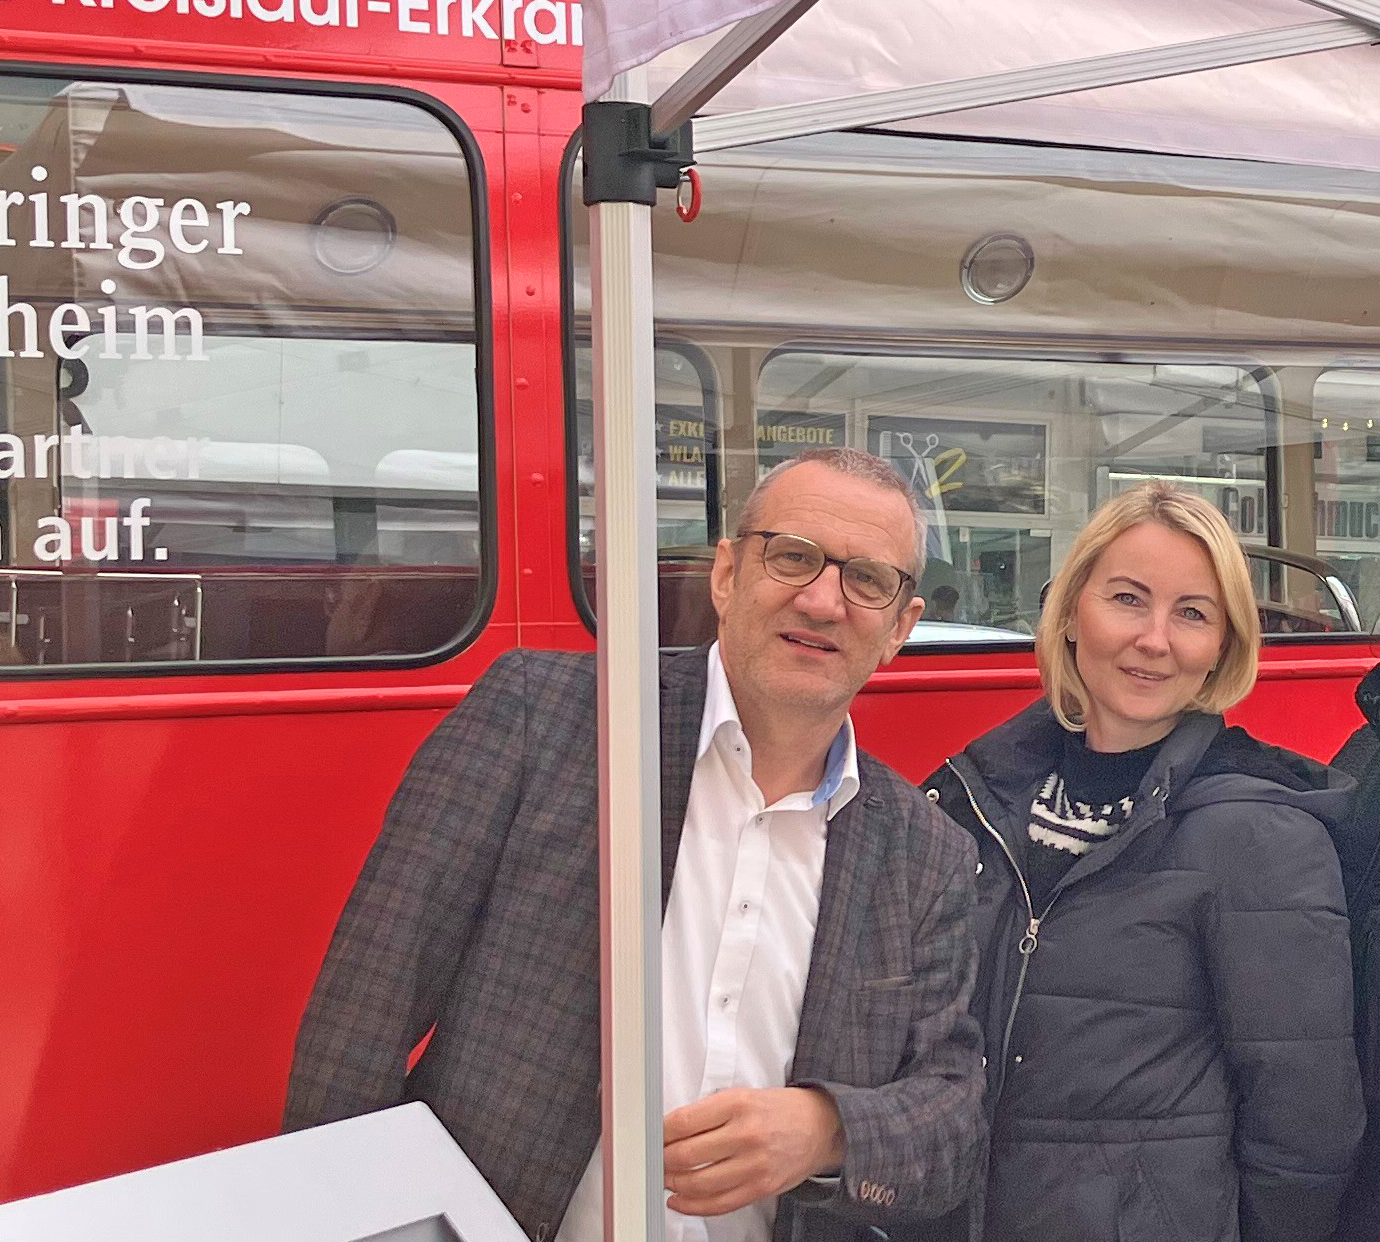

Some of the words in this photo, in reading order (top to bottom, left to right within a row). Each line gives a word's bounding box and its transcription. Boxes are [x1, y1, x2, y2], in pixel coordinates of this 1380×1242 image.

[0, 166, 251, 270] ringer
[0, 275, 209, 361] heim
[757, 424, 834, 445] ANGEBOTE
[33, 498, 169, 561] auf.
